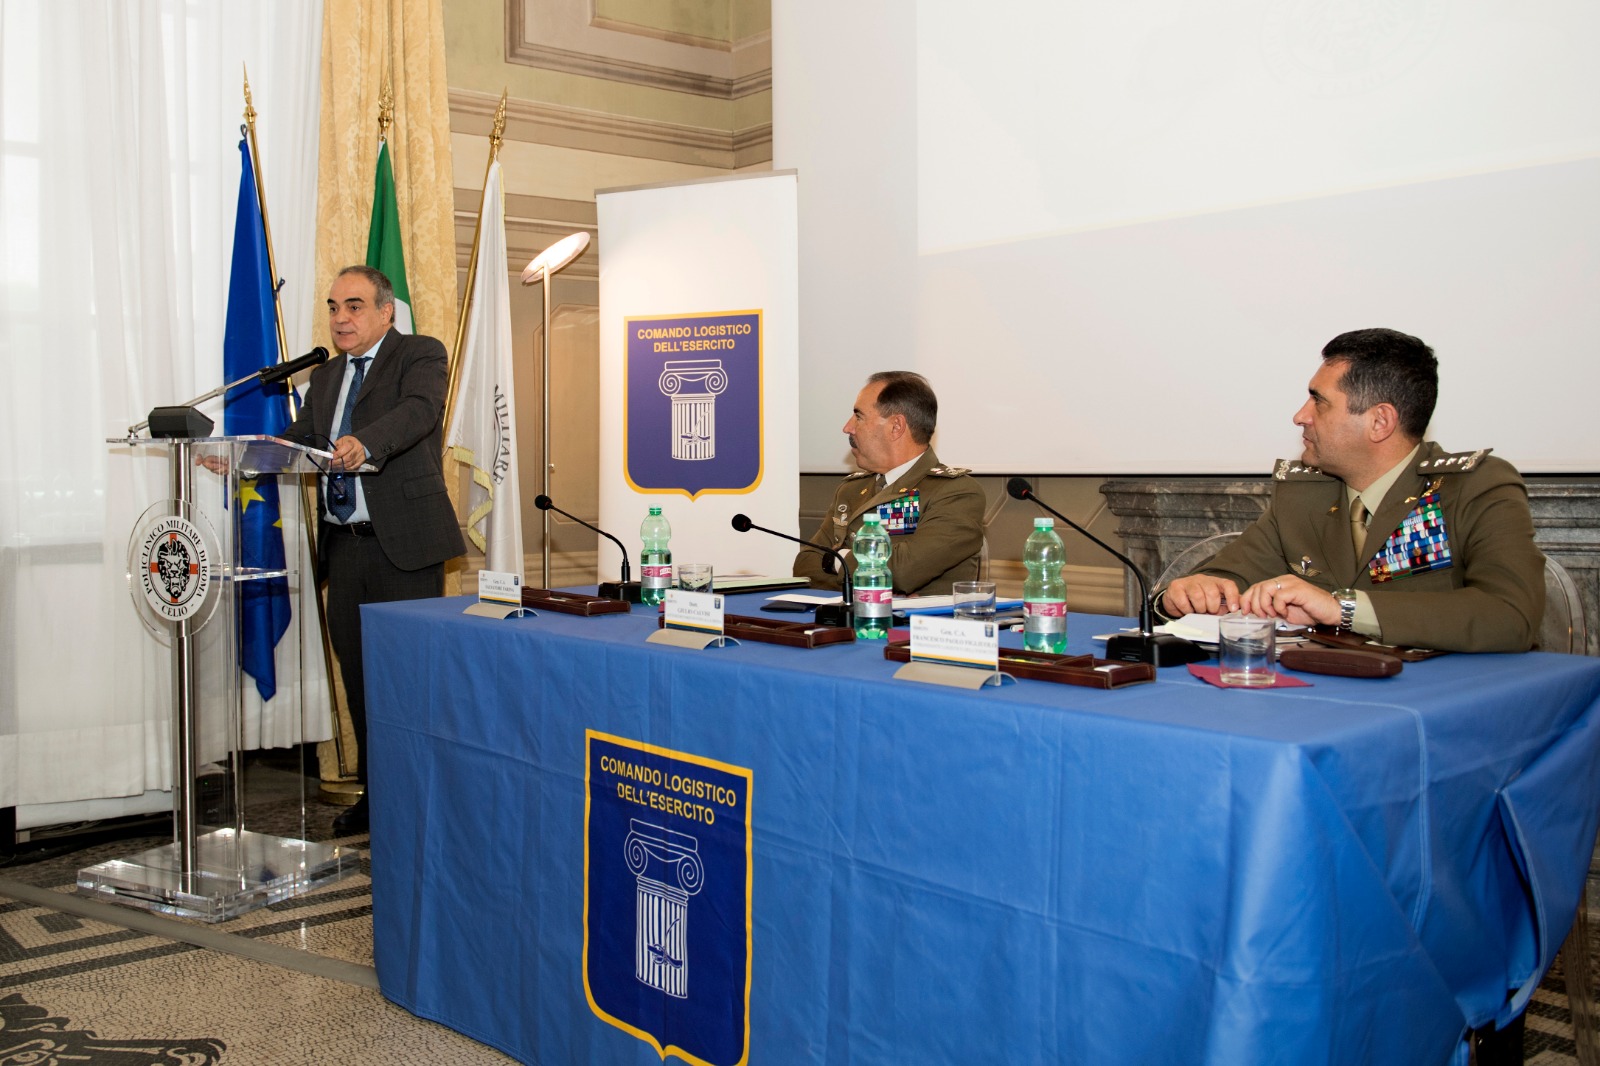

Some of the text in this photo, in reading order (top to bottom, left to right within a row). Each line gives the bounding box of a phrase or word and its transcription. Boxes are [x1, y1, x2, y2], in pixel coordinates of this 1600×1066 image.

[637, 323, 752, 339] COMANDO LOGISTICO
[653, 339, 735, 353] DELL'ESERCITO
[141, 520, 208, 597] POLICLINICO MILITARE DI ROMA
[161, 605, 188, 617] CELIO
[600, 755, 736, 807] COMANDO LOGISTICO
[617, 782, 715, 825] DELL'ESERCITO
